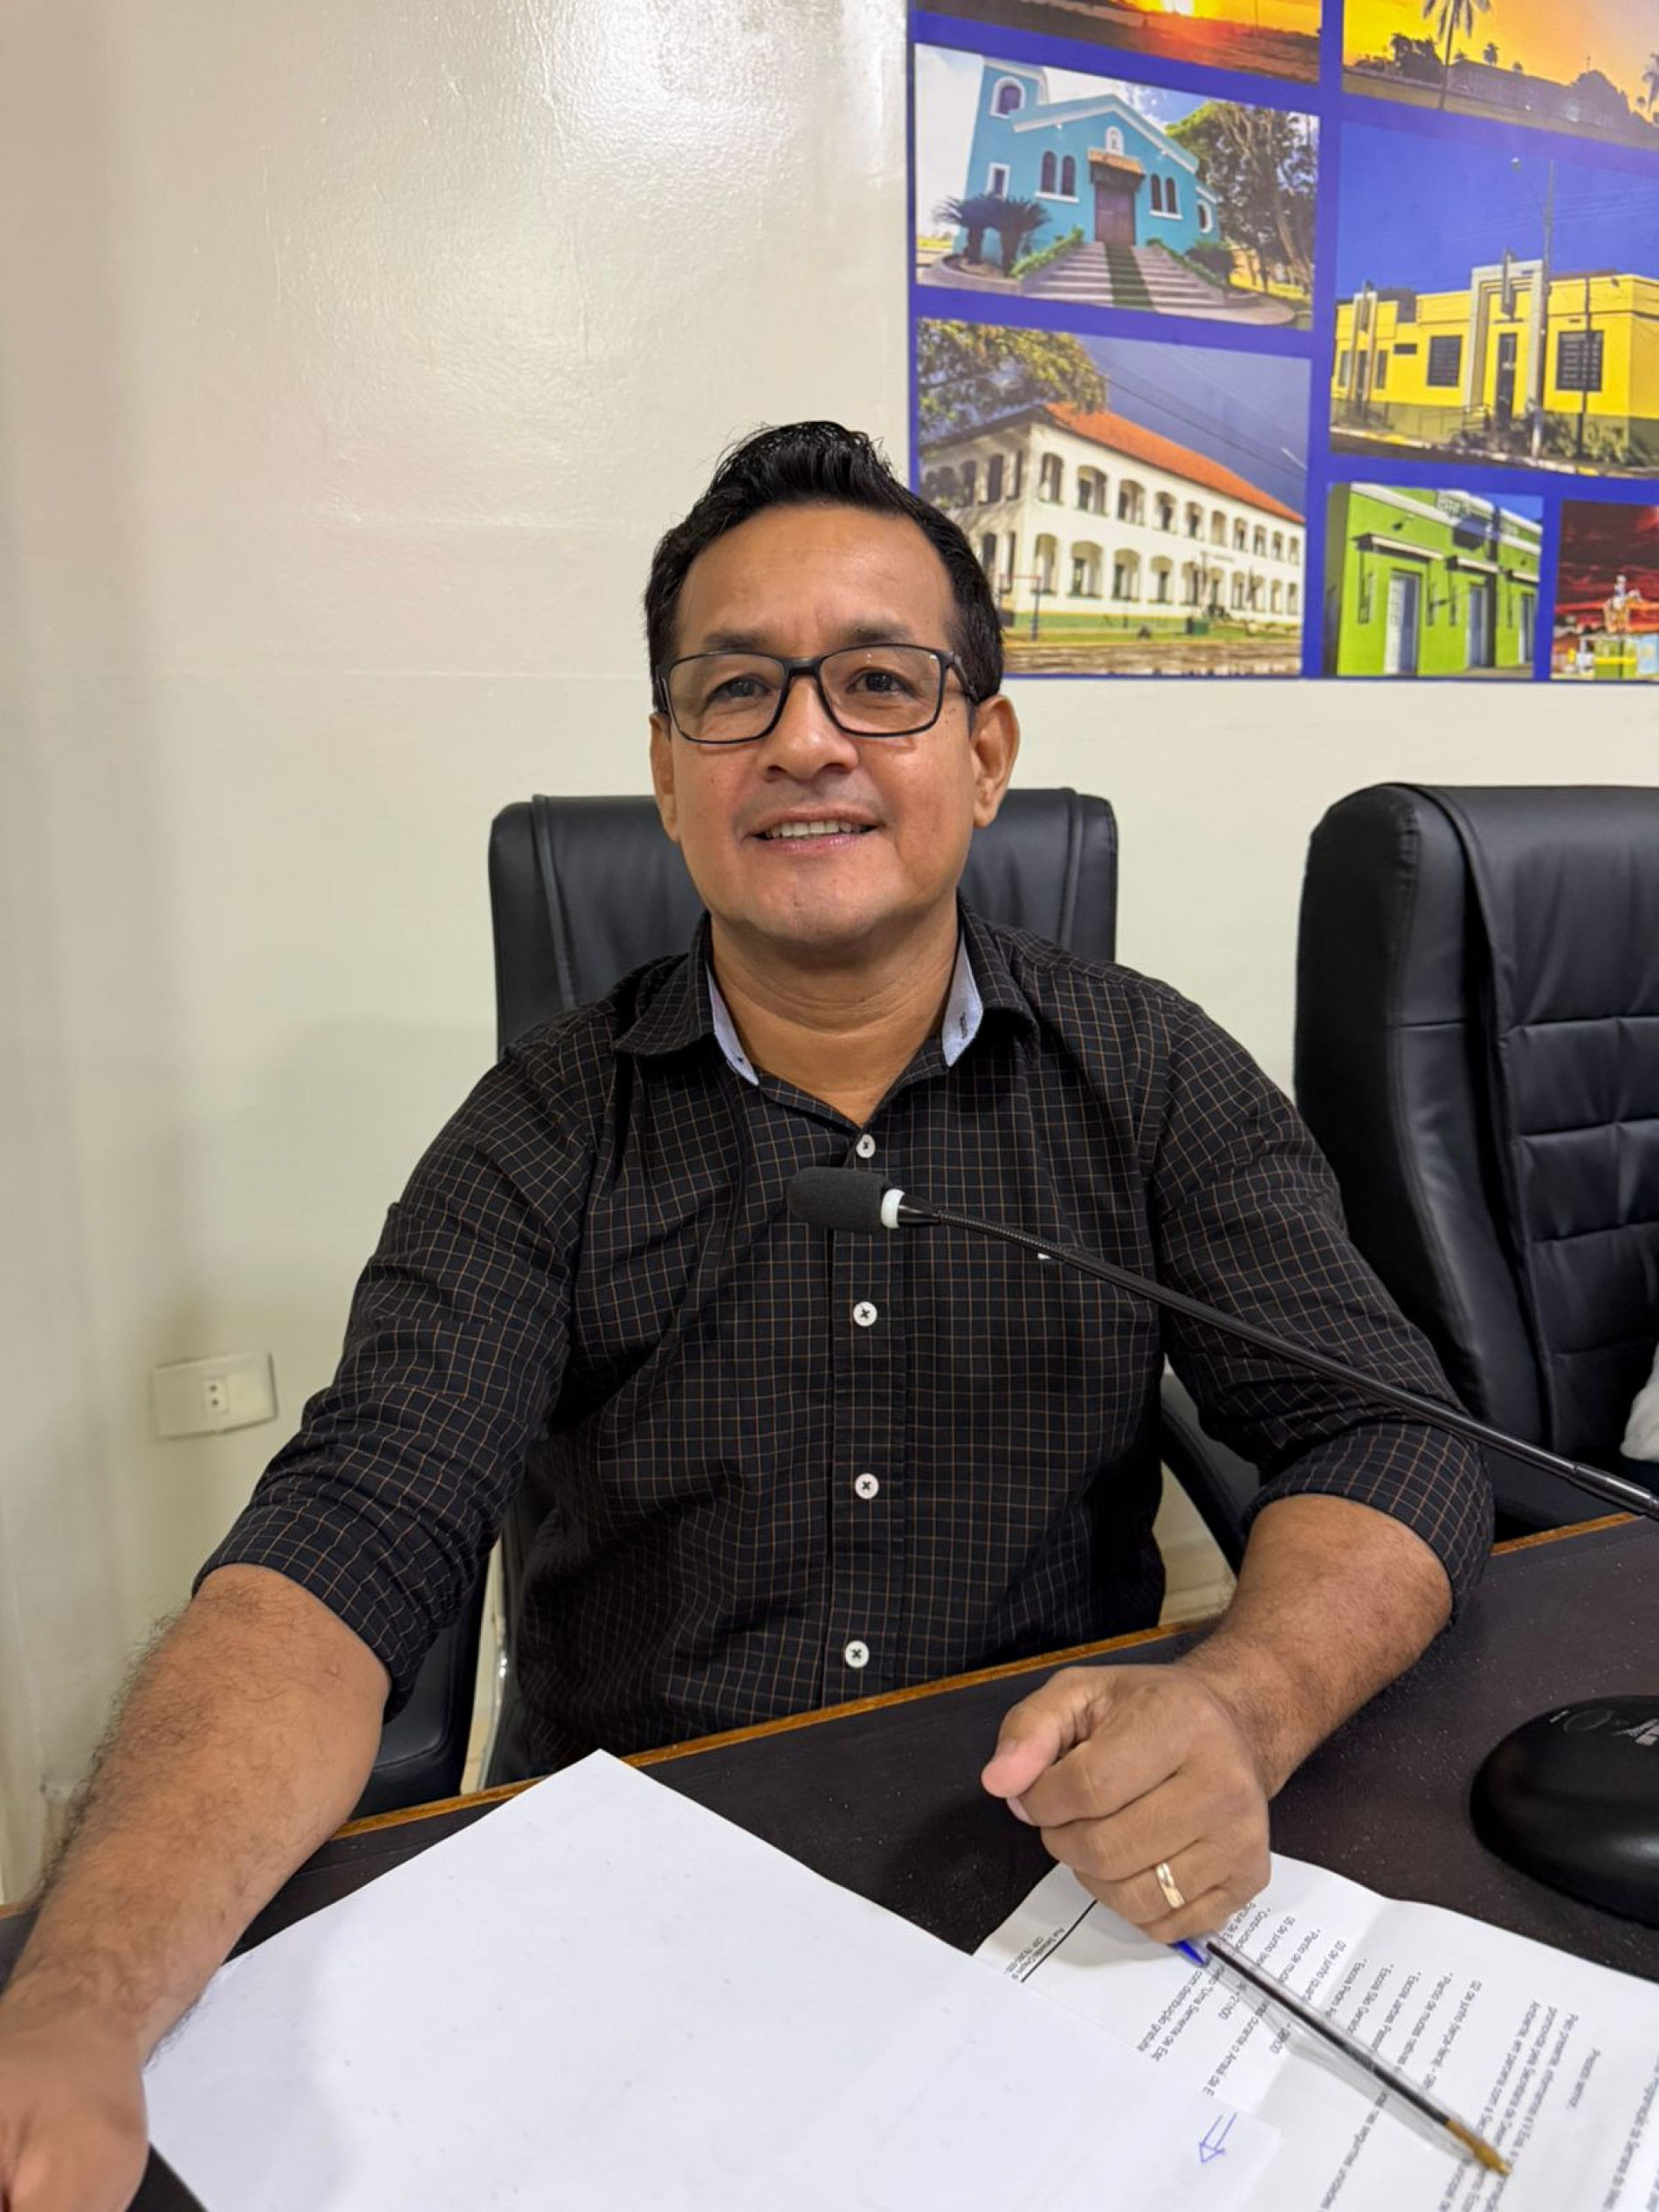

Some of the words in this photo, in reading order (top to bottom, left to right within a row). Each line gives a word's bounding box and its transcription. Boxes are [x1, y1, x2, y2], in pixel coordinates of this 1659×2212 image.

[1276, 1924, 1289, 1935] de
[1263, 1932, 1281, 1954] junho
[1297, 1931, 1318, 1954] Plantio
[1291, 1952, 1303, 1965] de
[1326, 1948, 1339, 1961] de
[1187, 1968, 1203, 1986] com
[1315, 1957, 1333, 1980] junho
[1344, 1960, 1366, 1986] Escola
[1369, 1966, 1392, 1992] Escola
[1331, 1983, 1352, 2008] Pedro
[1360, 1989, 1378, 2008] São
[1397, 1974, 1420, 2000] Escola
[1424, 1999, 1437, 2012] de
[1452, 2000, 1470, 2024] junho
[1169, 2002, 1201, 2037] Semente
[1235, 2016, 1260, 2046] durante
[1411, 2009, 1432, 2038] mudas
[1161, 2034, 1175, 2048] de
[1229, 2043, 1241, 2054] o
